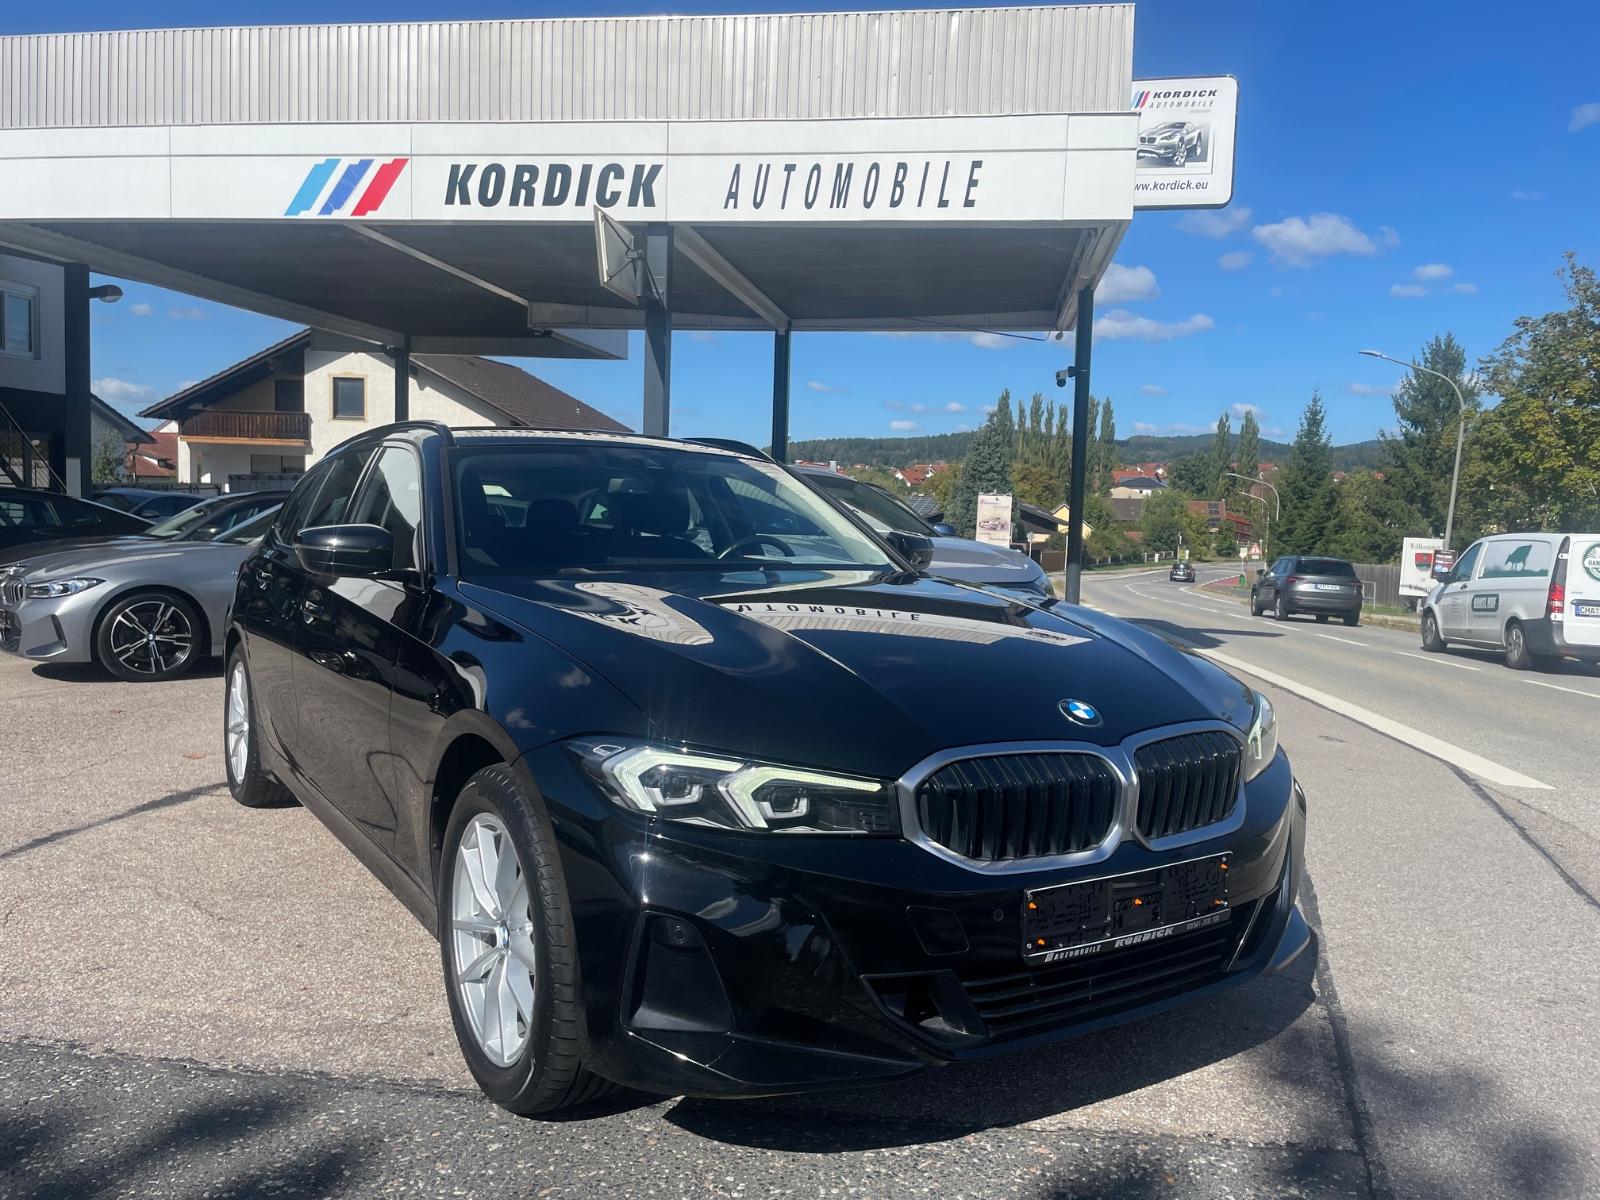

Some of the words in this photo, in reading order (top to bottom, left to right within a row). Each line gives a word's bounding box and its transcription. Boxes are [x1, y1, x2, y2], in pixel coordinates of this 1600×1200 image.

[1152, 89, 1218, 99] KORDICK
[1149, 100, 1214, 109] AUTOMOBILE
[444, 163, 663, 208] KORDICK
[724, 160, 983, 210] AUTOMOBILE
[1114, 927, 1175, 948] KORDICK
